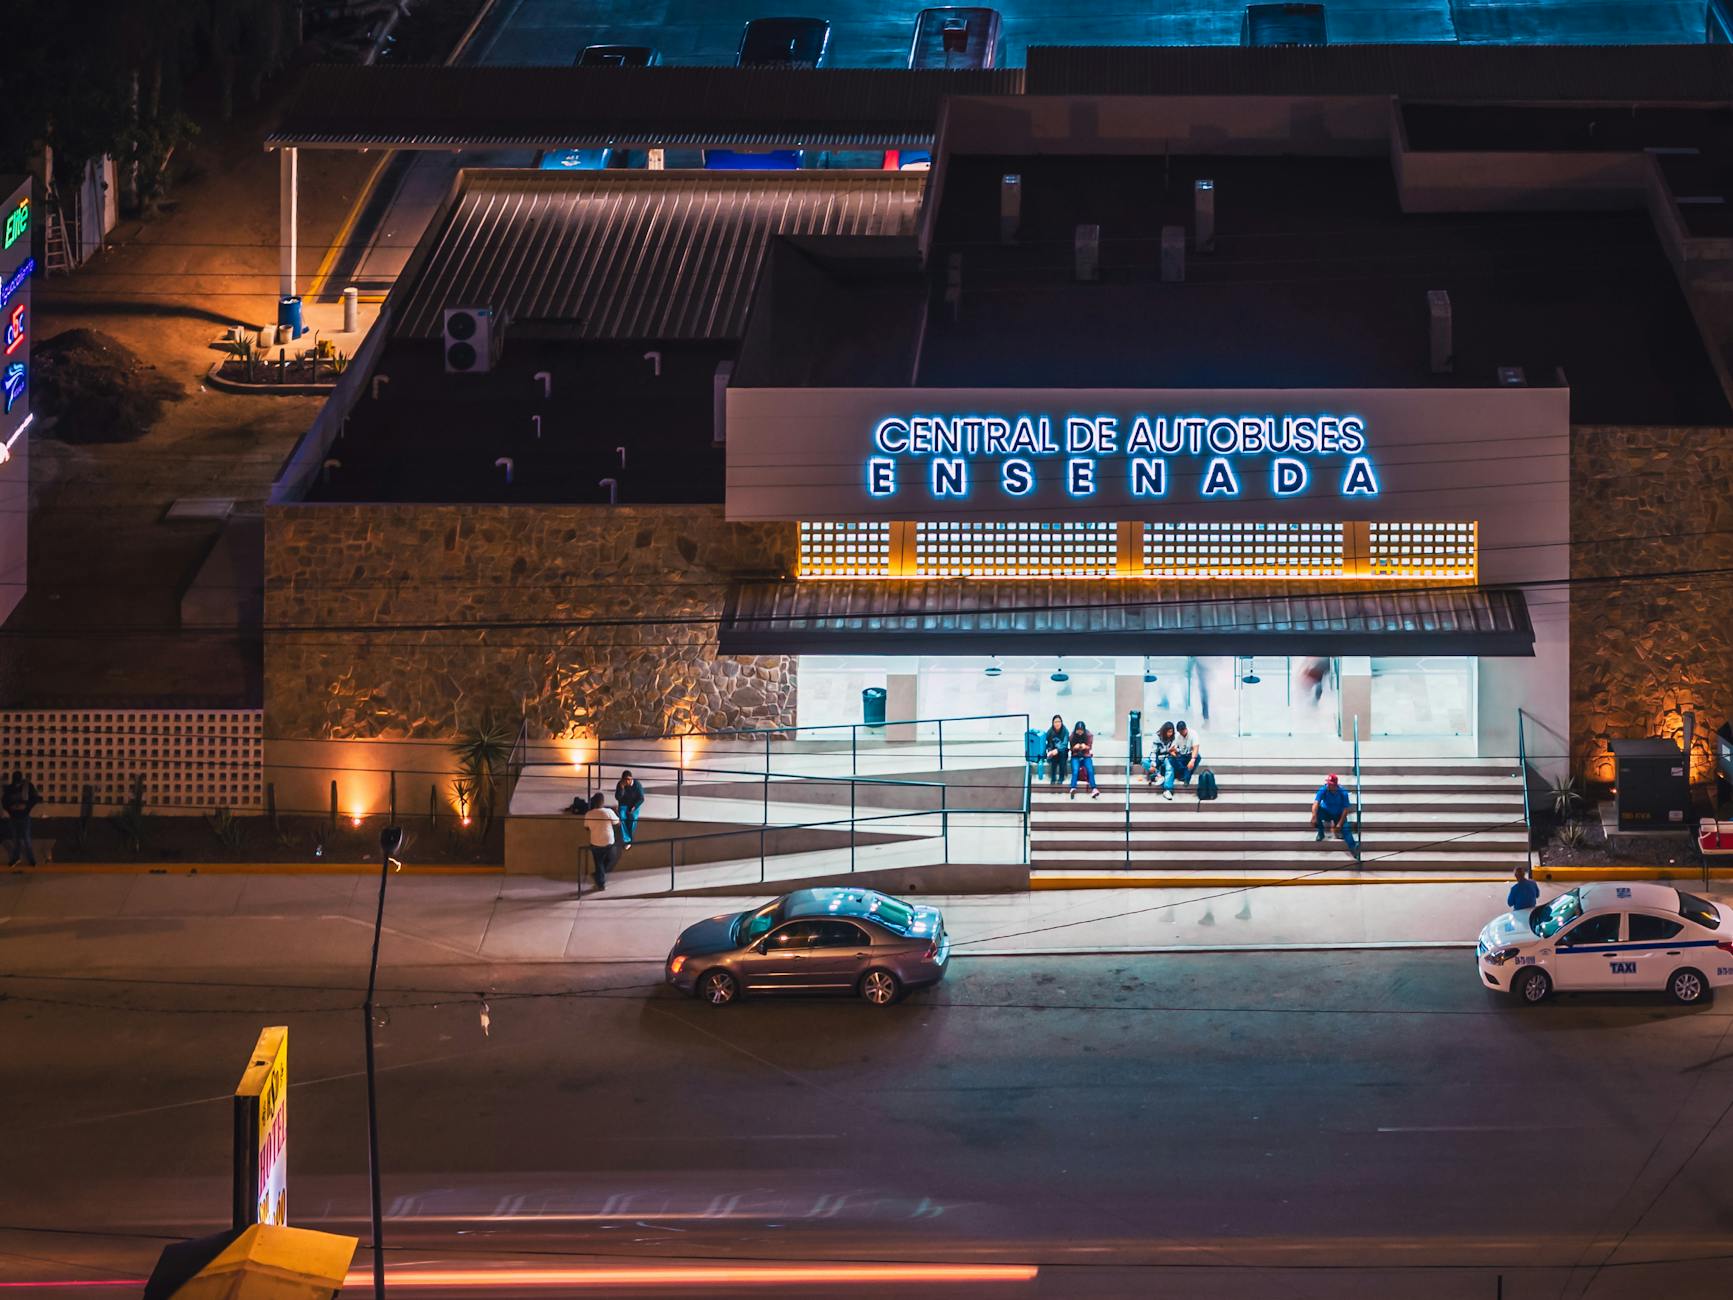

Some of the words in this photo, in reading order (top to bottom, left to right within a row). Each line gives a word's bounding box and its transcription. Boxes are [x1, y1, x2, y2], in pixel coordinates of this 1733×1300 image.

[4, 205, 29, 250] Elite
[877, 418, 1058, 453] CENTRAL
[1068, 418, 1117, 453] DE
[1128, 418, 1364, 453] AUTOBUSES
[871, 458, 1377, 495] ENSENADA
[1610, 961, 1637, 974] TAXI
[258, 1098, 286, 1199] HOTEL
